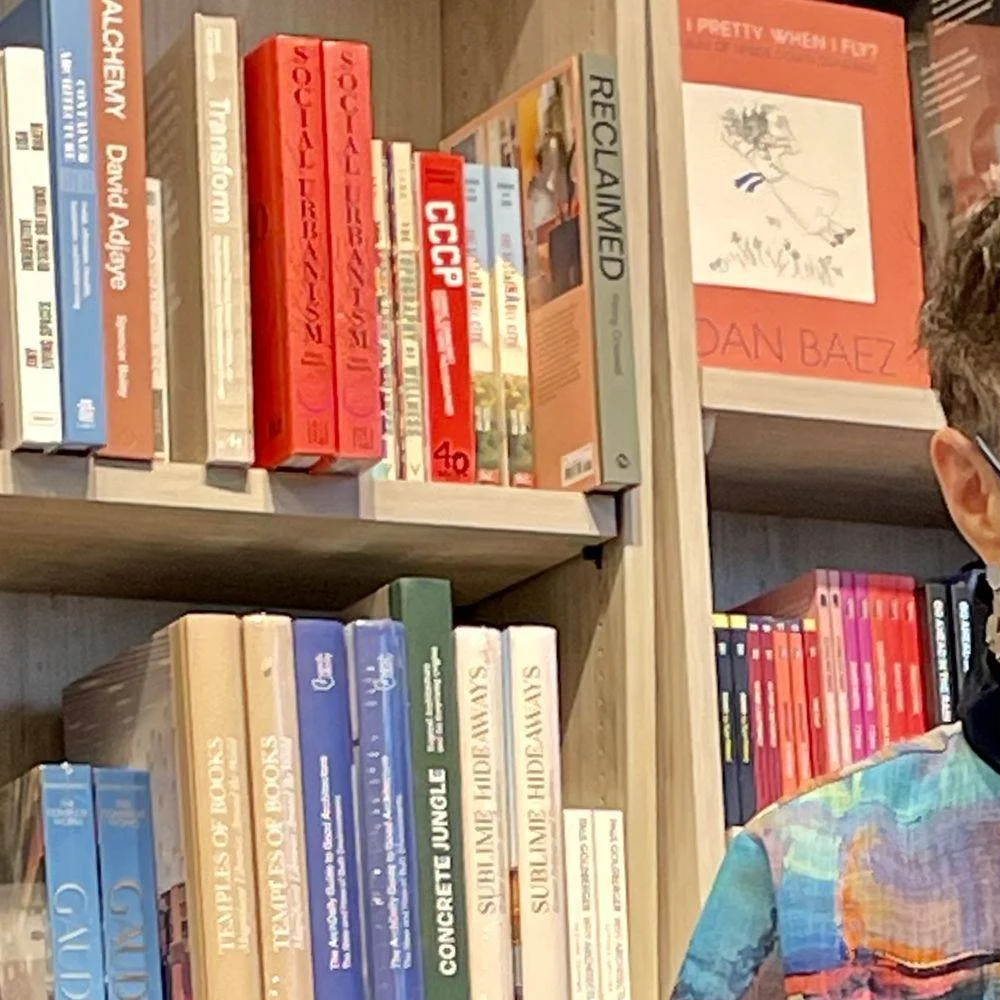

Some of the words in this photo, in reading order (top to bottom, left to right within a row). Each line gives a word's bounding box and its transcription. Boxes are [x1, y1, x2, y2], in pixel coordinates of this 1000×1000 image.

[100, 0, 127, 121] ALCHEMY
[697, 18, 764, 40] PRETTY
[770, 28, 826, 49] WHEN
[292, 46, 315, 169] SOCIAL
[339, 51, 361, 175] SOCIAL
[104, 143, 129, 207] David
[207, 99, 234, 224] Transform
[589, 73, 624, 282] RECLAIMED
[106, 212, 131, 291] Adjaye
[298, 178, 325, 346] URBANISM
[345, 184, 369, 350] URBANISM
[424, 201, 464, 288] CCCP
[801, 328, 897, 377] BAEZ
[432, 440, 469, 474] 40
[261, 735, 281, 814] BOOKS
[468, 665, 492, 801] HIDEAWAYS
[523, 665, 546, 799] HIDEAWAYS
[207, 736, 226, 815] BOOKS
[429, 768, 450, 852] JUNGLE
[211, 823, 229, 848] OF
[265, 821, 284, 847] OF
[321, 822, 333, 850] Good
[323, 851, 333, 863] to
[382, 822, 394, 850] Good
[473, 809, 497, 915] SUBLIME
[528, 809, 550, 914] SUBLIME
[211, 849, 237, 954] TEMPLES
[264, 848, 291, 953] TEMPLES
[324, 865, 337, 896] Guide
[430, 855, 457, 976] CONCRETE
[329, 950, 340, 970] The
